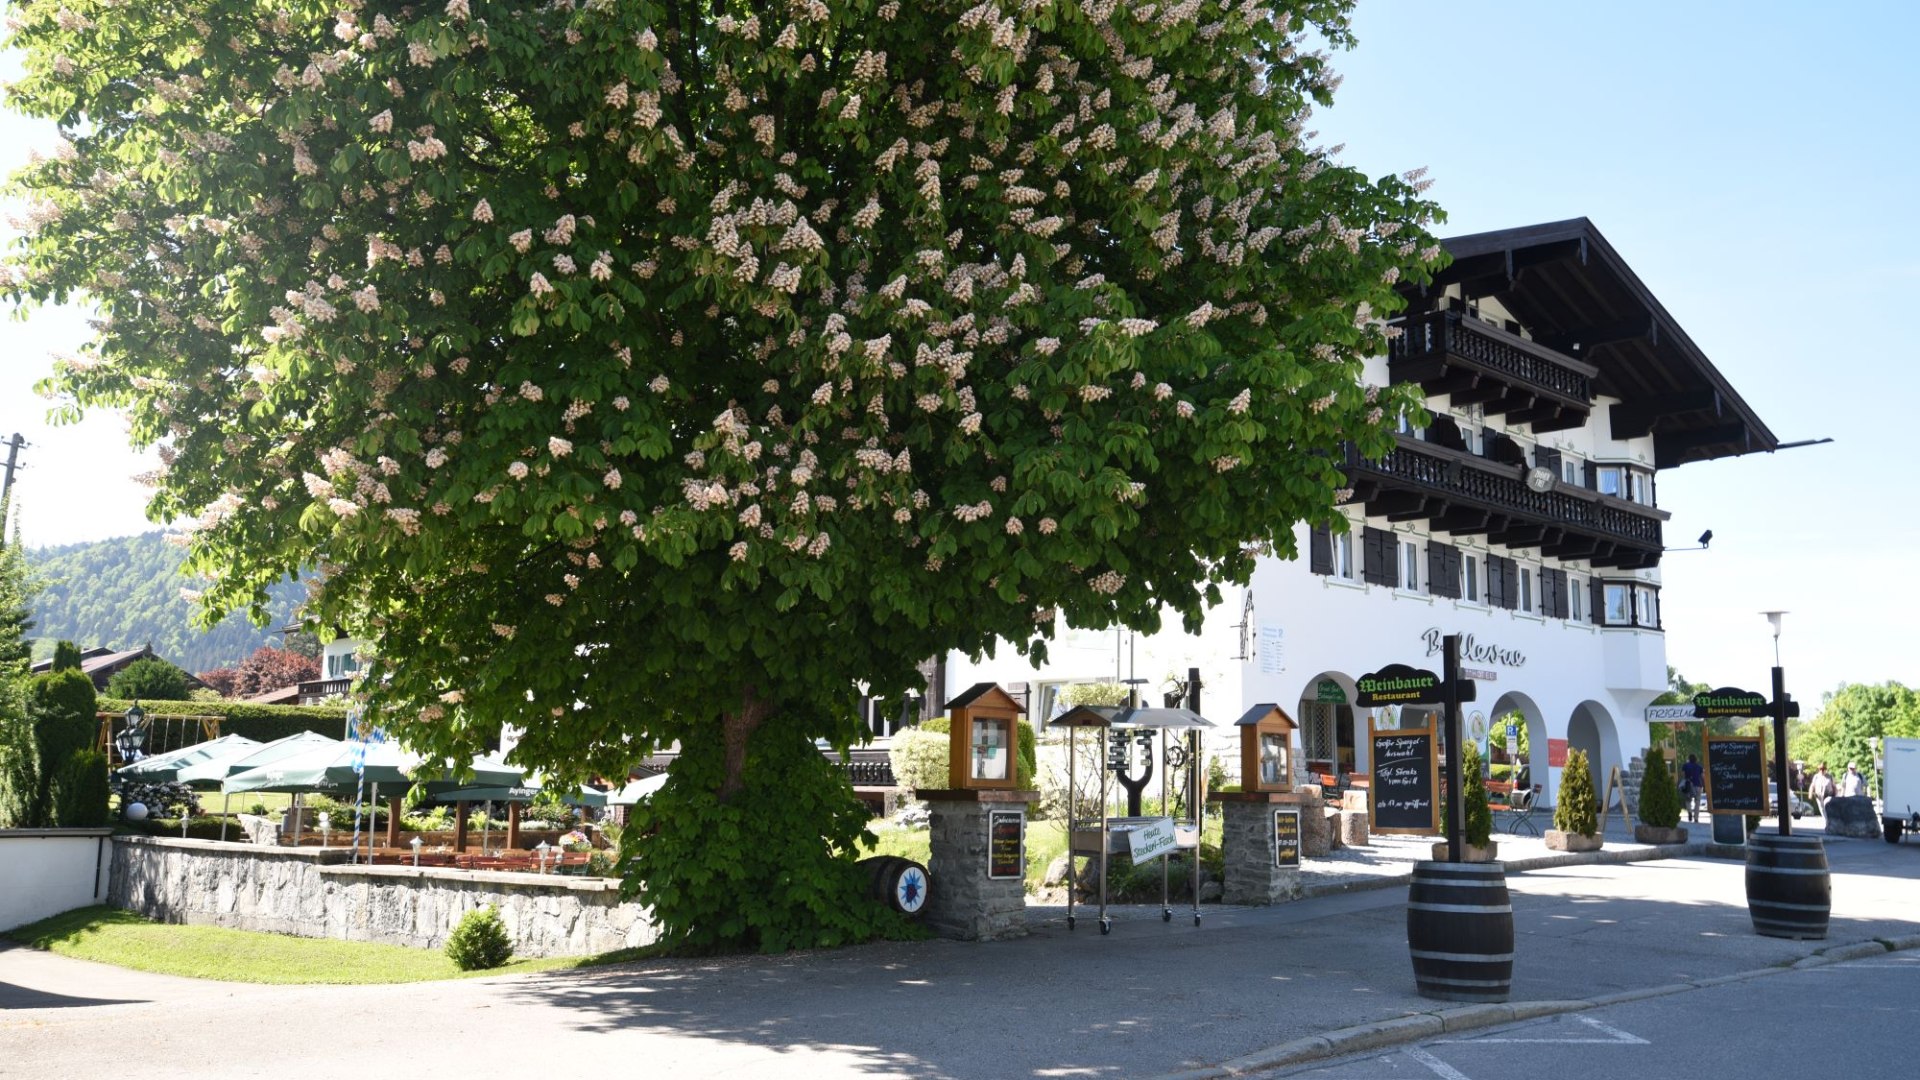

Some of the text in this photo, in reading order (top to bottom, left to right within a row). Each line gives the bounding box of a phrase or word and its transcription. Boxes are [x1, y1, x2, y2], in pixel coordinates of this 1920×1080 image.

[1421, 627, 1526, 667] Bllevue
[1360, 677, 1433, 692] Weinbauer
[1372, 691, 1420, 700] Restaurant
[1697, 696, 1763, 707] Weinbauer
[508, 787, 538, 796] Ayinger
[1144, 827, 1161, 841] Heute
